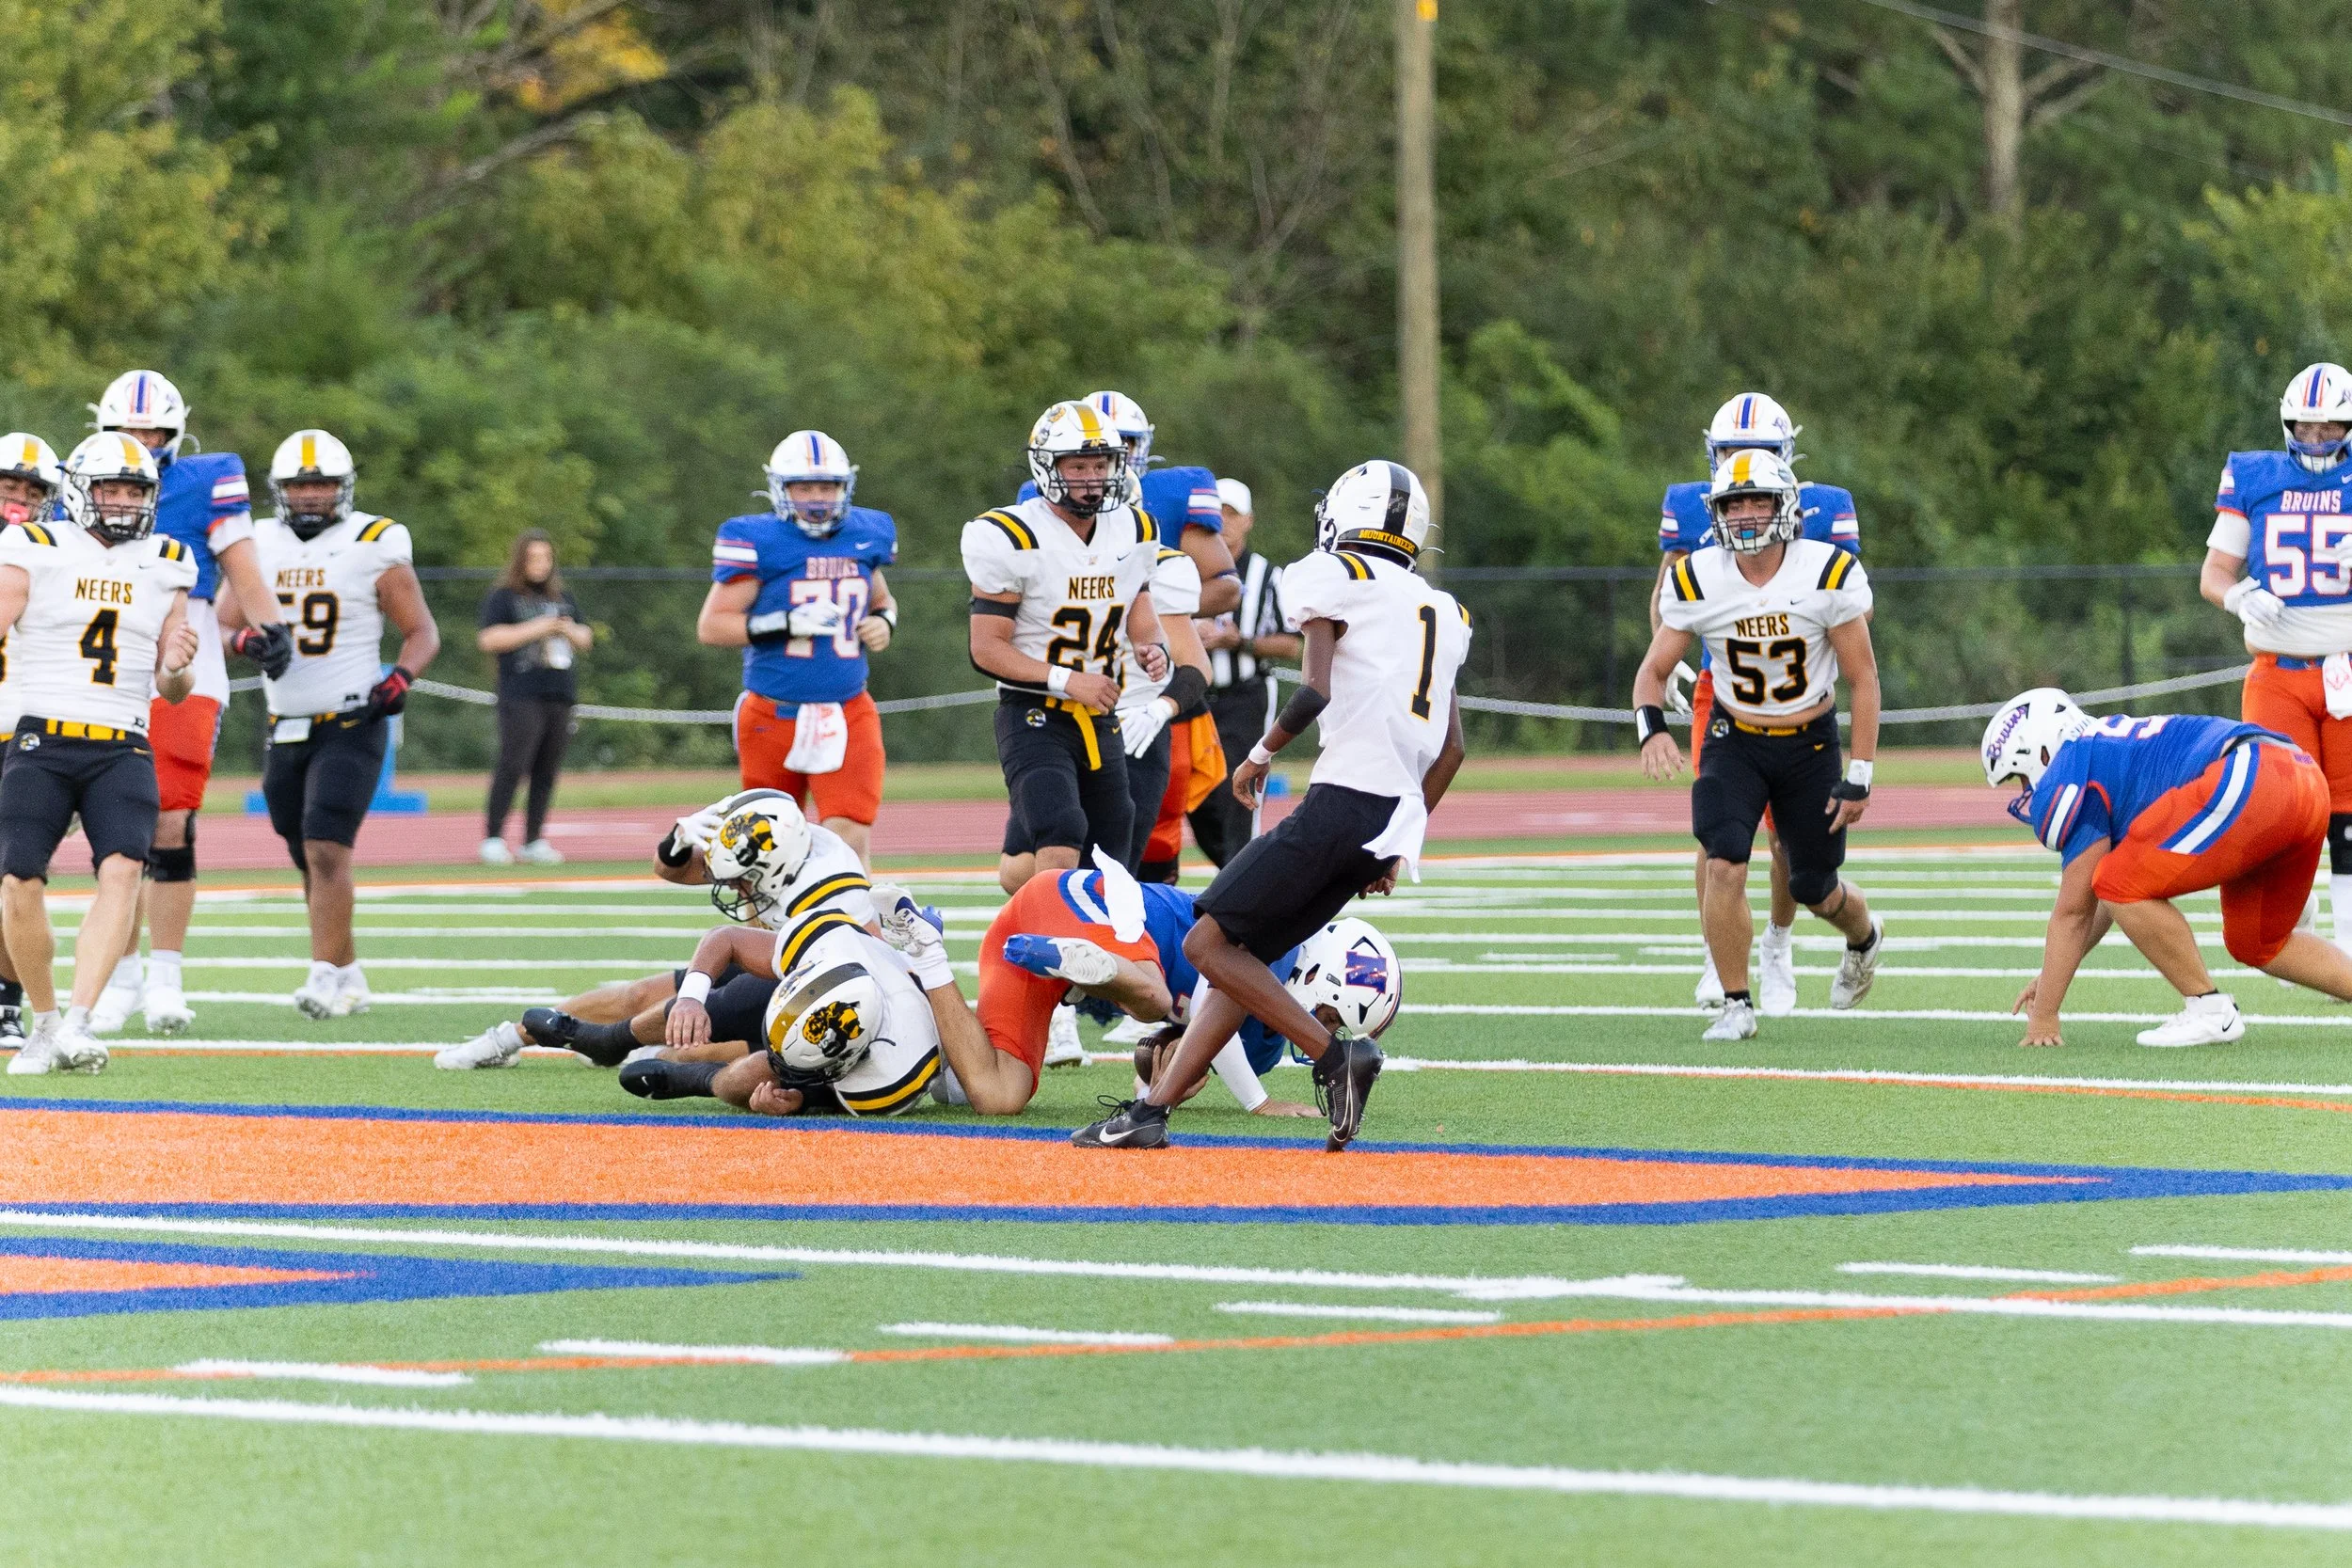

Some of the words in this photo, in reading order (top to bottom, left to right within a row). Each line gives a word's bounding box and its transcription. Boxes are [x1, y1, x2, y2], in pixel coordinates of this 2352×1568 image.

[2280, 490, 2342, 513] BRUINS
[1358, 528, 1416, 555] MOUNTAINEERS
[2264, 513, 2352, 598] 55
[75, 576, 134, 605] NEERS
[276, 567, 326, 588] NEERS
[1068, 576, 1116, 600] NEERS
[1734, 612, 1789, 638] NEERS
[78, 607, 120, 689] 4
[1045, 603, 1126, 679] 24
[1410, 602, 1438, 721] 1
[1724, 636, 1810, 707] 53
